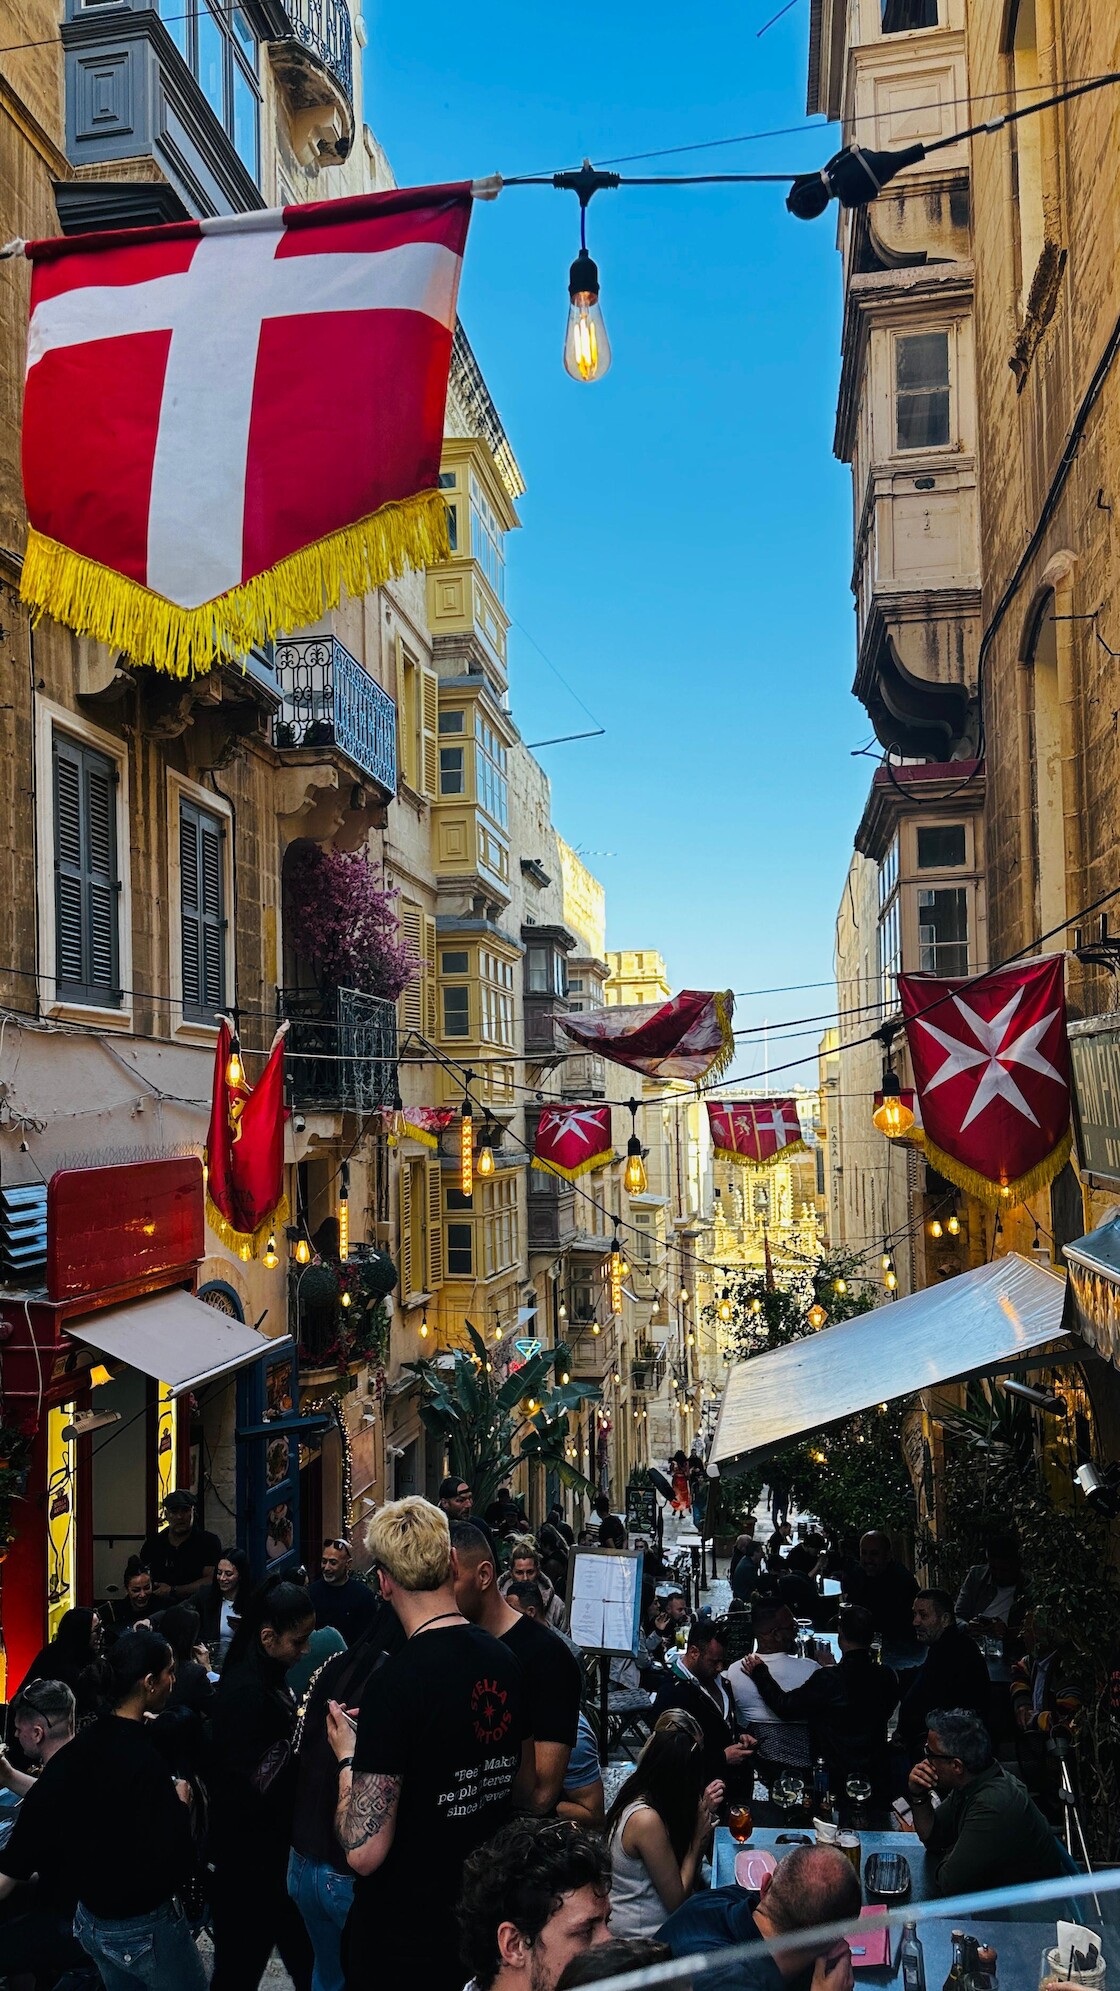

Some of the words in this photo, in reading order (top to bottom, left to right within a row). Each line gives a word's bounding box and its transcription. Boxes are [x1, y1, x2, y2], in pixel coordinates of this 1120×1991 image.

[471, 1679, 508, 1711] STELLA
[472, 1709, 512, 1744] ARTOIS
[446, 1802, 478, 1817] since
